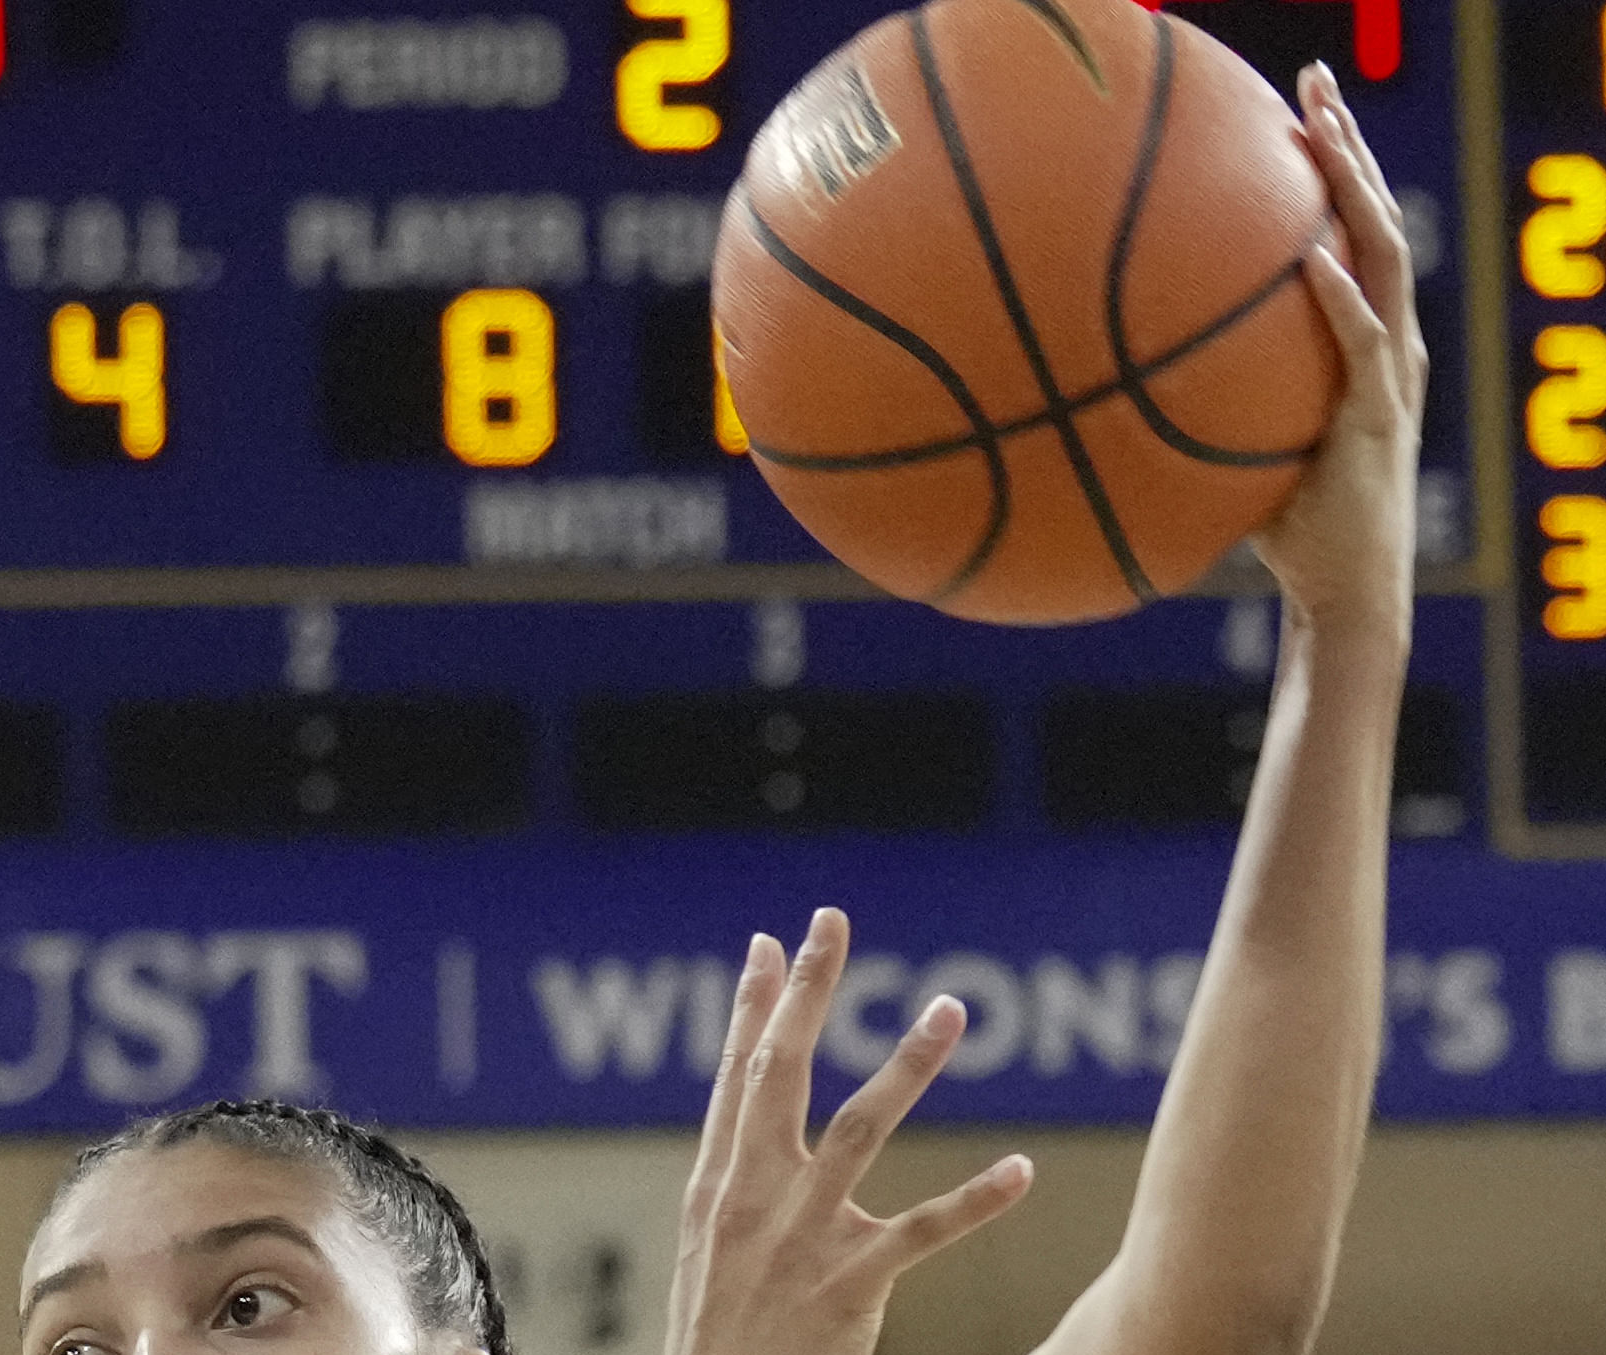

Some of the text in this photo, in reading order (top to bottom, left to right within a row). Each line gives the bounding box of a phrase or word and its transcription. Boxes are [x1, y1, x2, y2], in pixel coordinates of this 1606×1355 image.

[616, 0, 730, 150] 2
[287, 198, 586, 287] PLAYER
[50, 302, 166, 460] 4
[441, 287, 557, 467] 8
